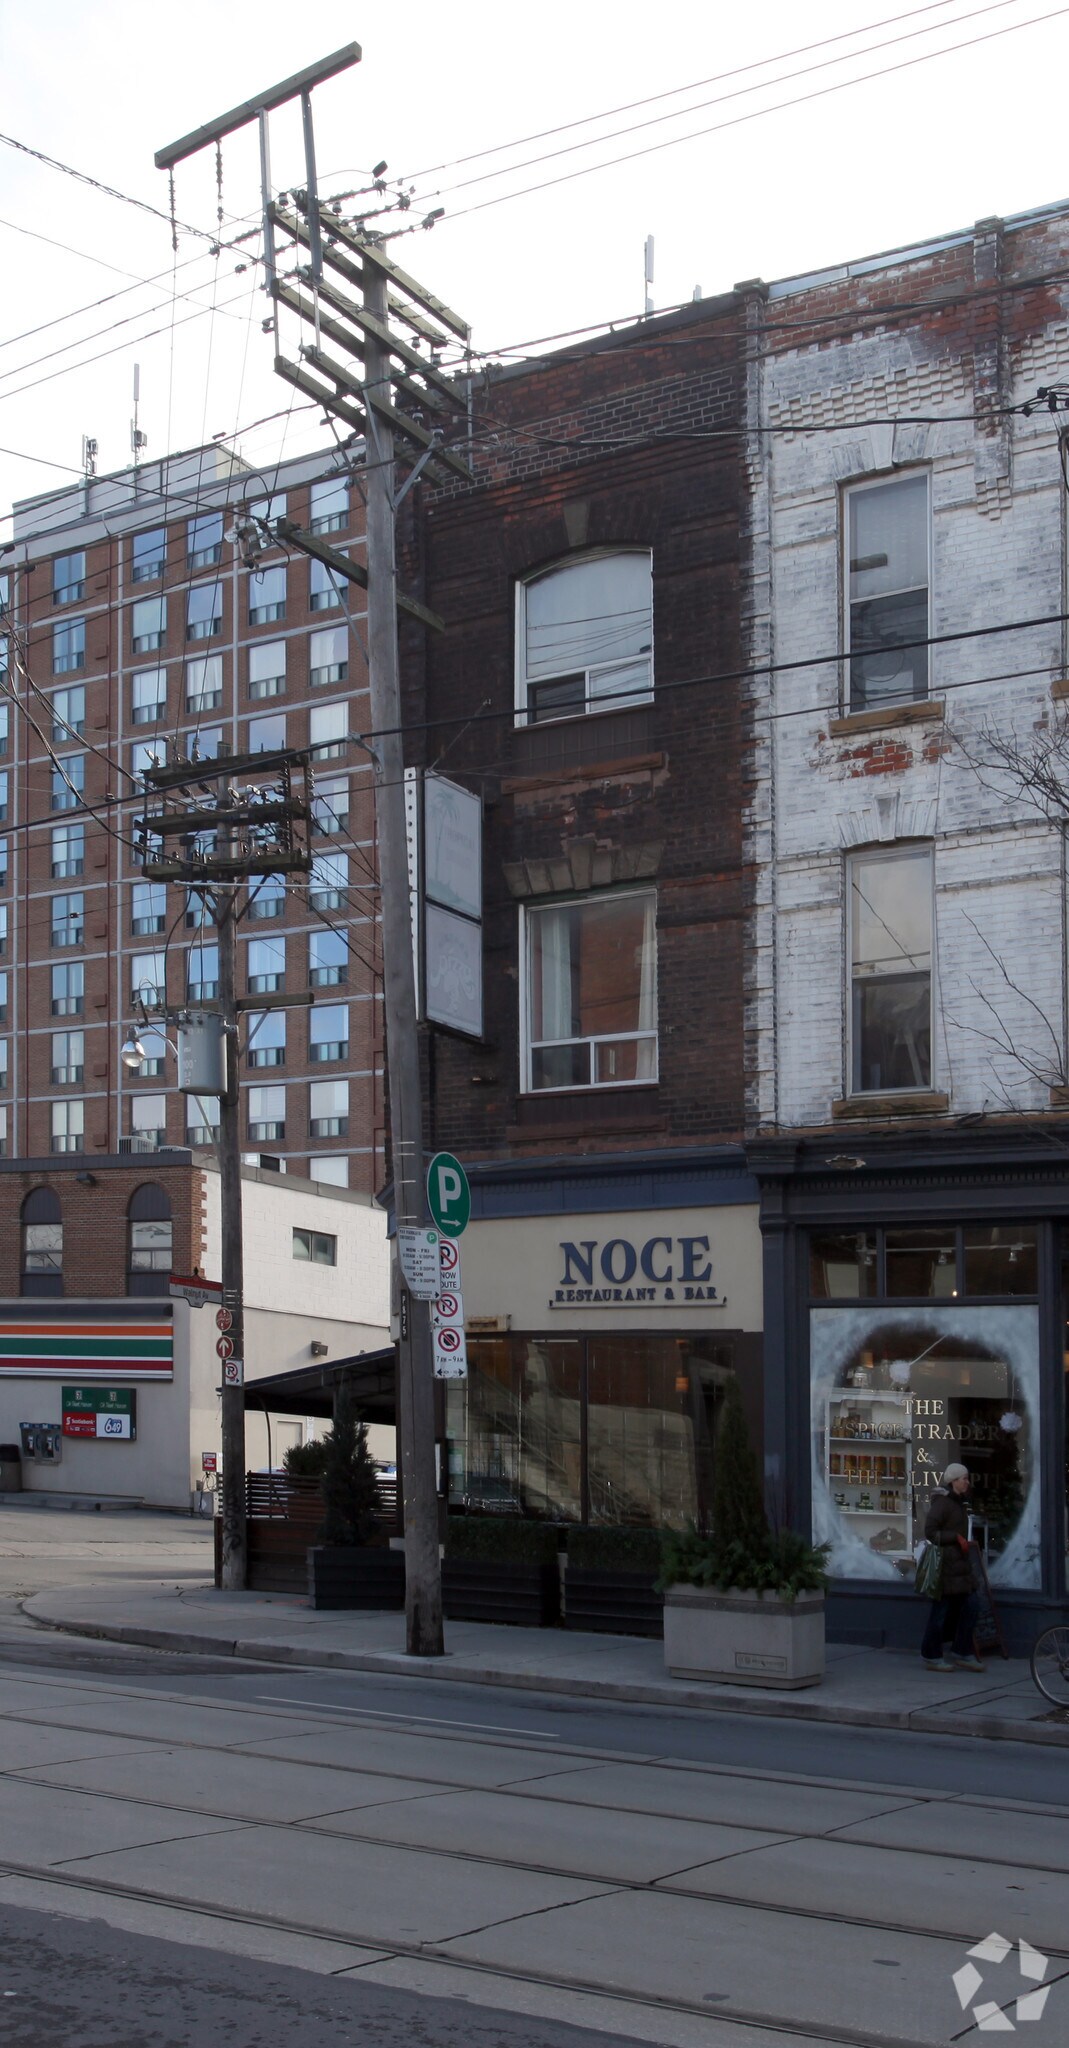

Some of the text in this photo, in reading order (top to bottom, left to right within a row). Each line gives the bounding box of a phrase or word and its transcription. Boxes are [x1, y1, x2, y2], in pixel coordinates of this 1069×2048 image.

[437, 1166, 461, 1212] P
[559, 1235, 713, 1286] NOCE
[554, 1286, 718, 1303] RESTAURANT & BAR
[901, 1399, 944, 1416] THE
[845, 1422, 1001, 1440] SPICE TRADER
[916, 1447, 930, 1463] &
[844, 1468, 884, 1485] THE
[971, 1472, 1005, 1490] PIT
